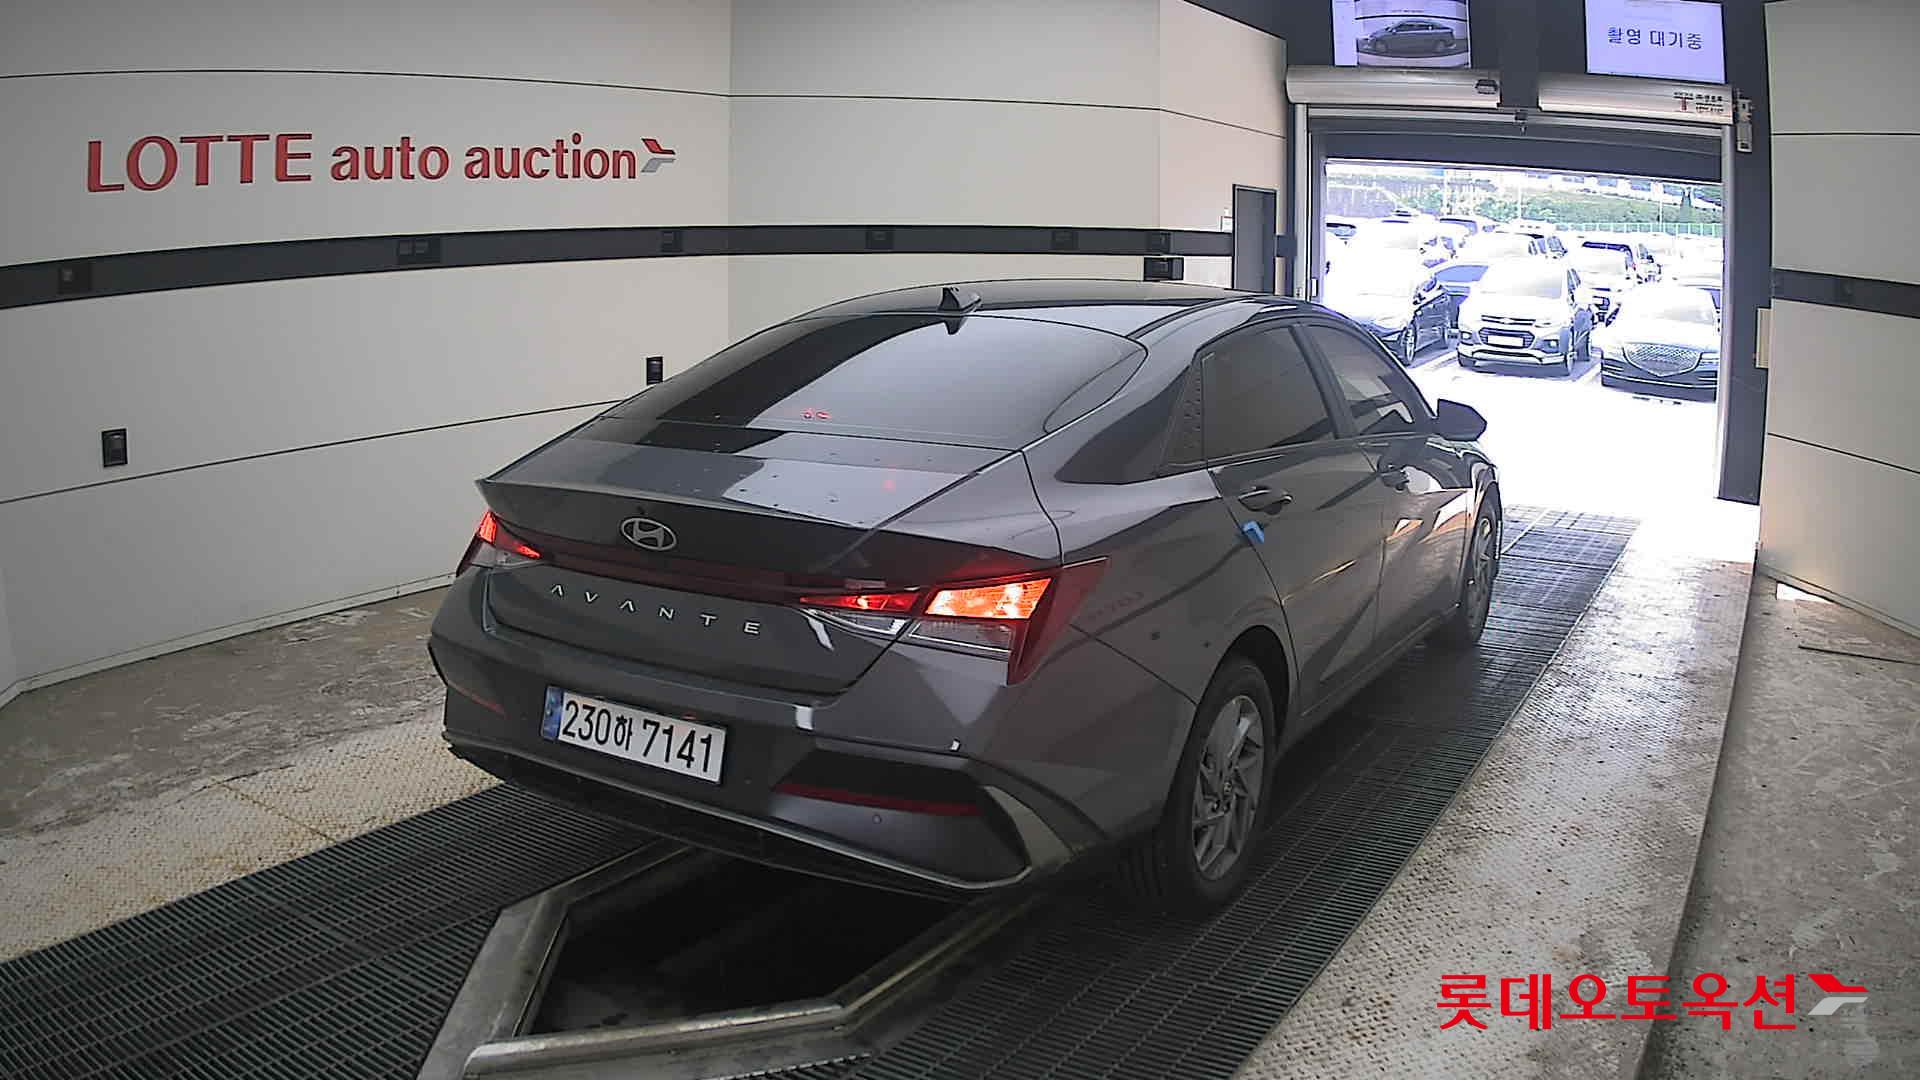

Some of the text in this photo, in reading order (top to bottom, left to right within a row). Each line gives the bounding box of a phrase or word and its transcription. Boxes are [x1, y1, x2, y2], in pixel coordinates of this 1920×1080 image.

[1607, 26, 1702, 50] 촬영 대기중
[87, 133, 638, 193] LOTTE auto auction
[550, 583, 761, 634] AVANTE
[562, 700, 713, 773] 230하 7141
